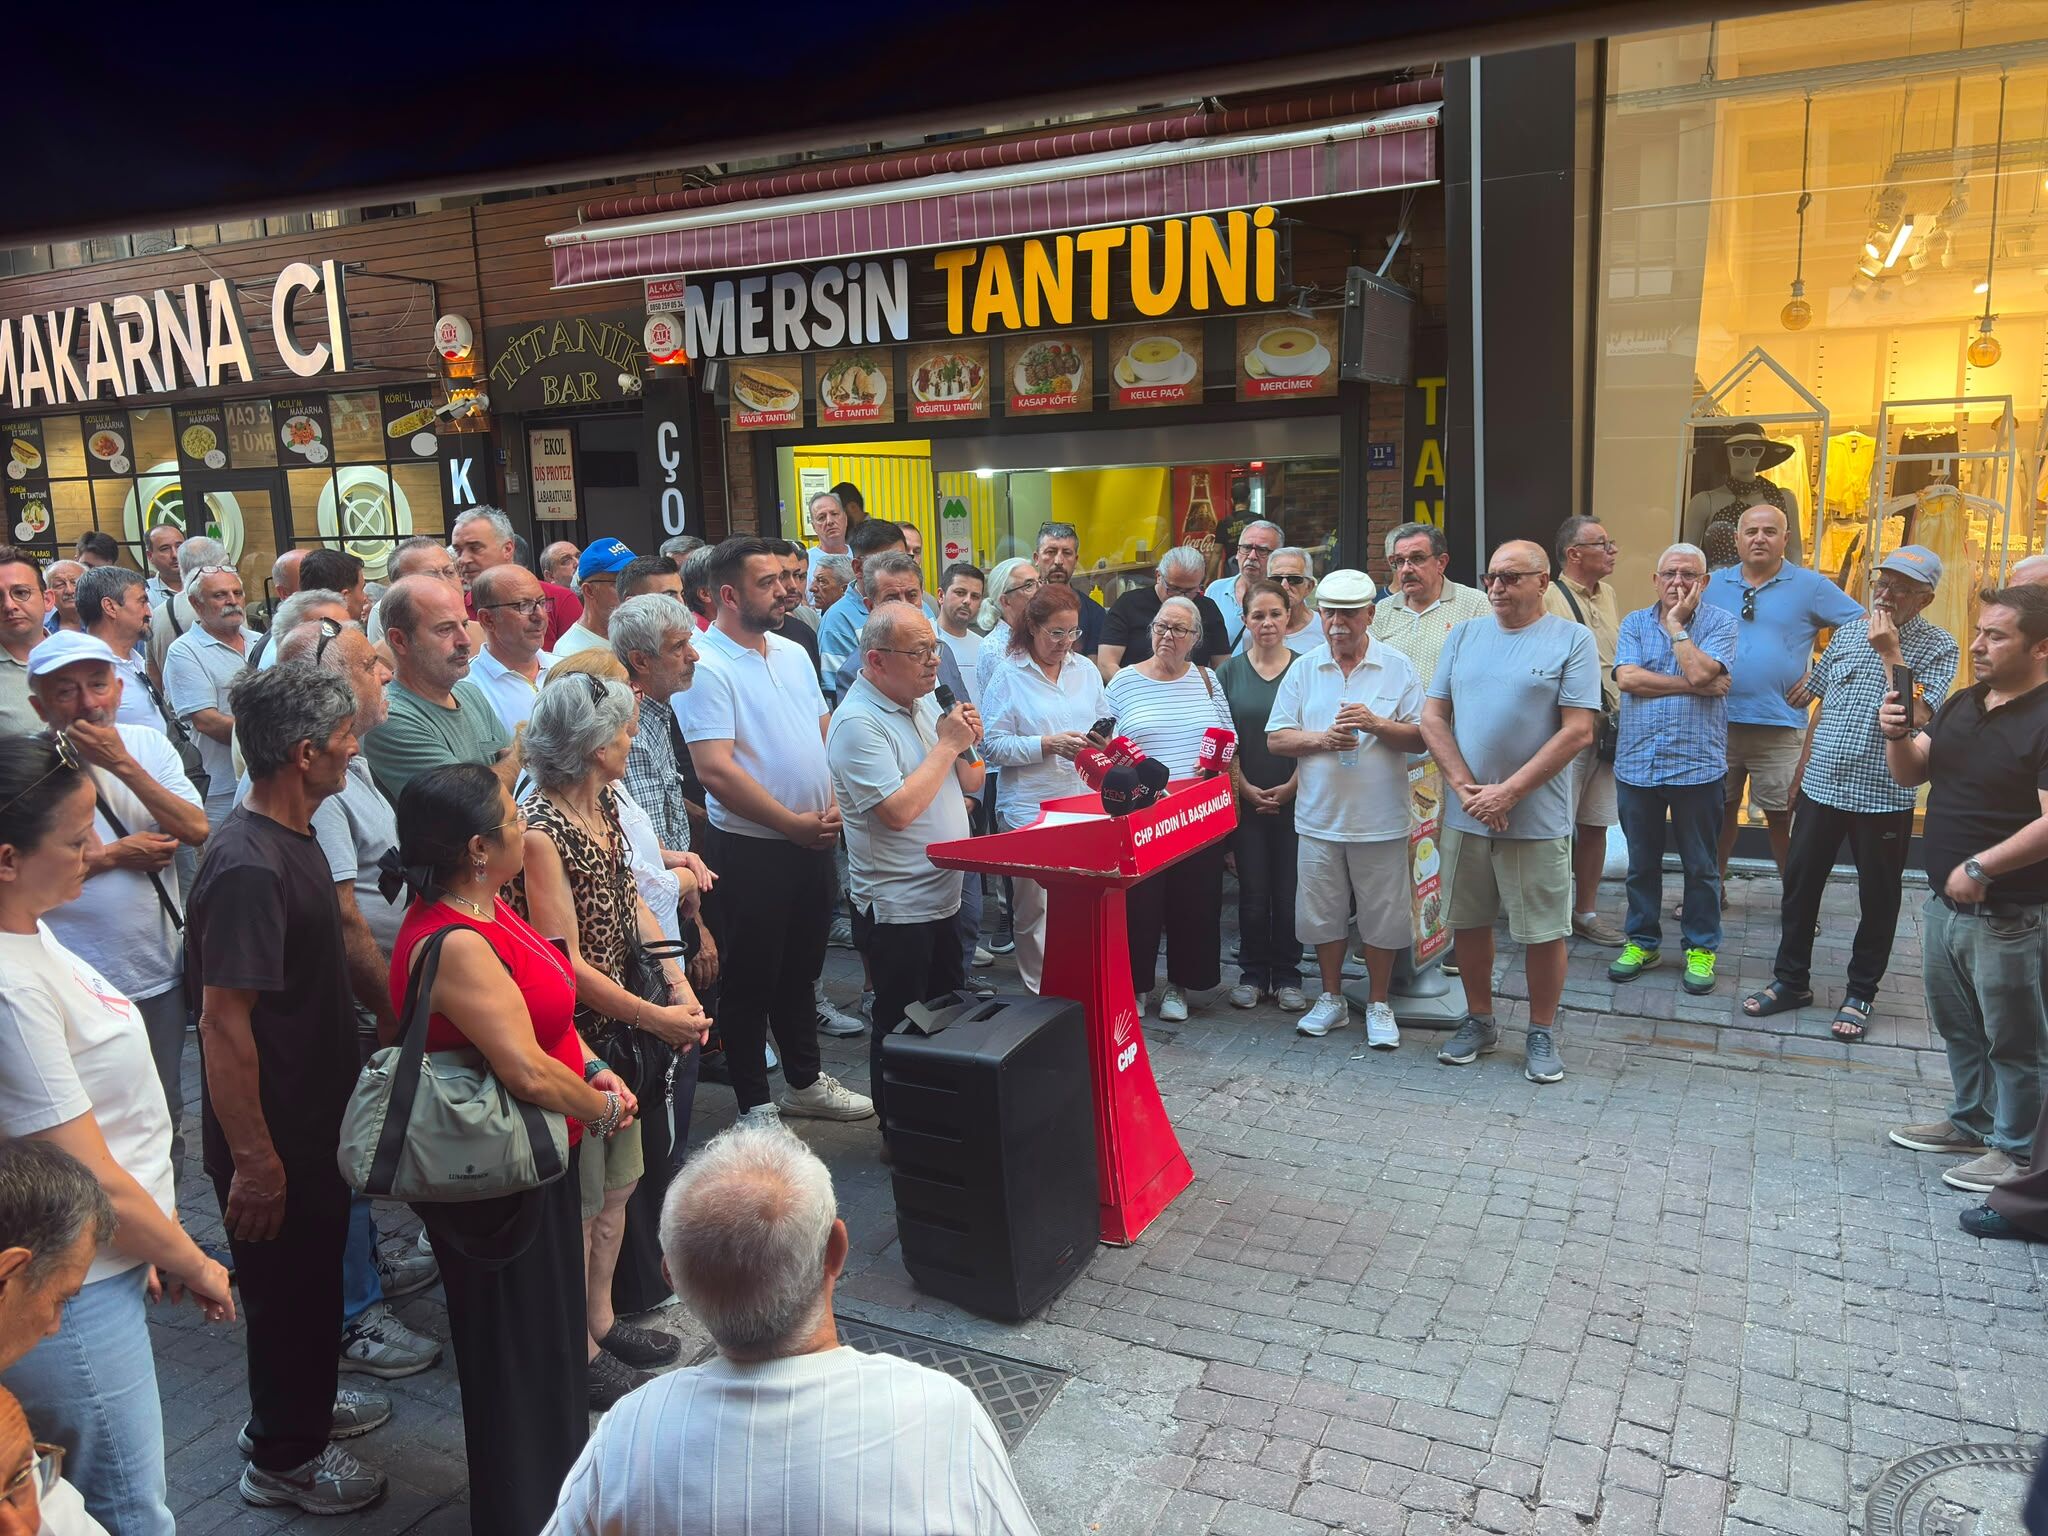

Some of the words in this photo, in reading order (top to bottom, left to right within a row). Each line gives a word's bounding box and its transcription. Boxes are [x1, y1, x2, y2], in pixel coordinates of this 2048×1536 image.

[648, 283, 675, 295] AL-KA
[272, 259, 346, 377] CI
[541, 371, 601, 405] BAR
[1260, 379, 1313, 392] MERCİMEK
[1130, 389, 1158, 400] KELLE
[1160, 388, 1185, 399] PAÇA
[410, 400, 434, 410] TAVUK
[1018, 397, 1047, 407] KASAP
[1049, 395, 1077, 405] KÖFTE
[290, 406, 323, 416] MAKARNA
[834, 410, 845, 418] ET
[846, 407, 879, 417] TANTUNİ
[915, 404, 951, 413] YOĞURTLU
[953, 402, 983, 411] TANTUNİ
[740, 414, 764, 423] TAVUK
[765, 412, 796, 422] TANTUNİ
[96, 421, 124, 430] MAKARNA
[544, 438, 566, 455] EKOL
[1374, 447, 1385, 459] 11
[534, 464, 546, 484] DİŞ
[546, 465, 572, 481] PROTEZ
[449, 458, 477, 505] K
[945, 546, 969, 554] Edenred
[1134, 826, 1153, 847] CHP
[1155, 815, 1180, 838] AYDIN
[1179, 809, 1188, 827] İL
[1187, 789, 1232, 823] BAŞKANLIĞI
[1117, 1042, 1138, 1072] CHP
